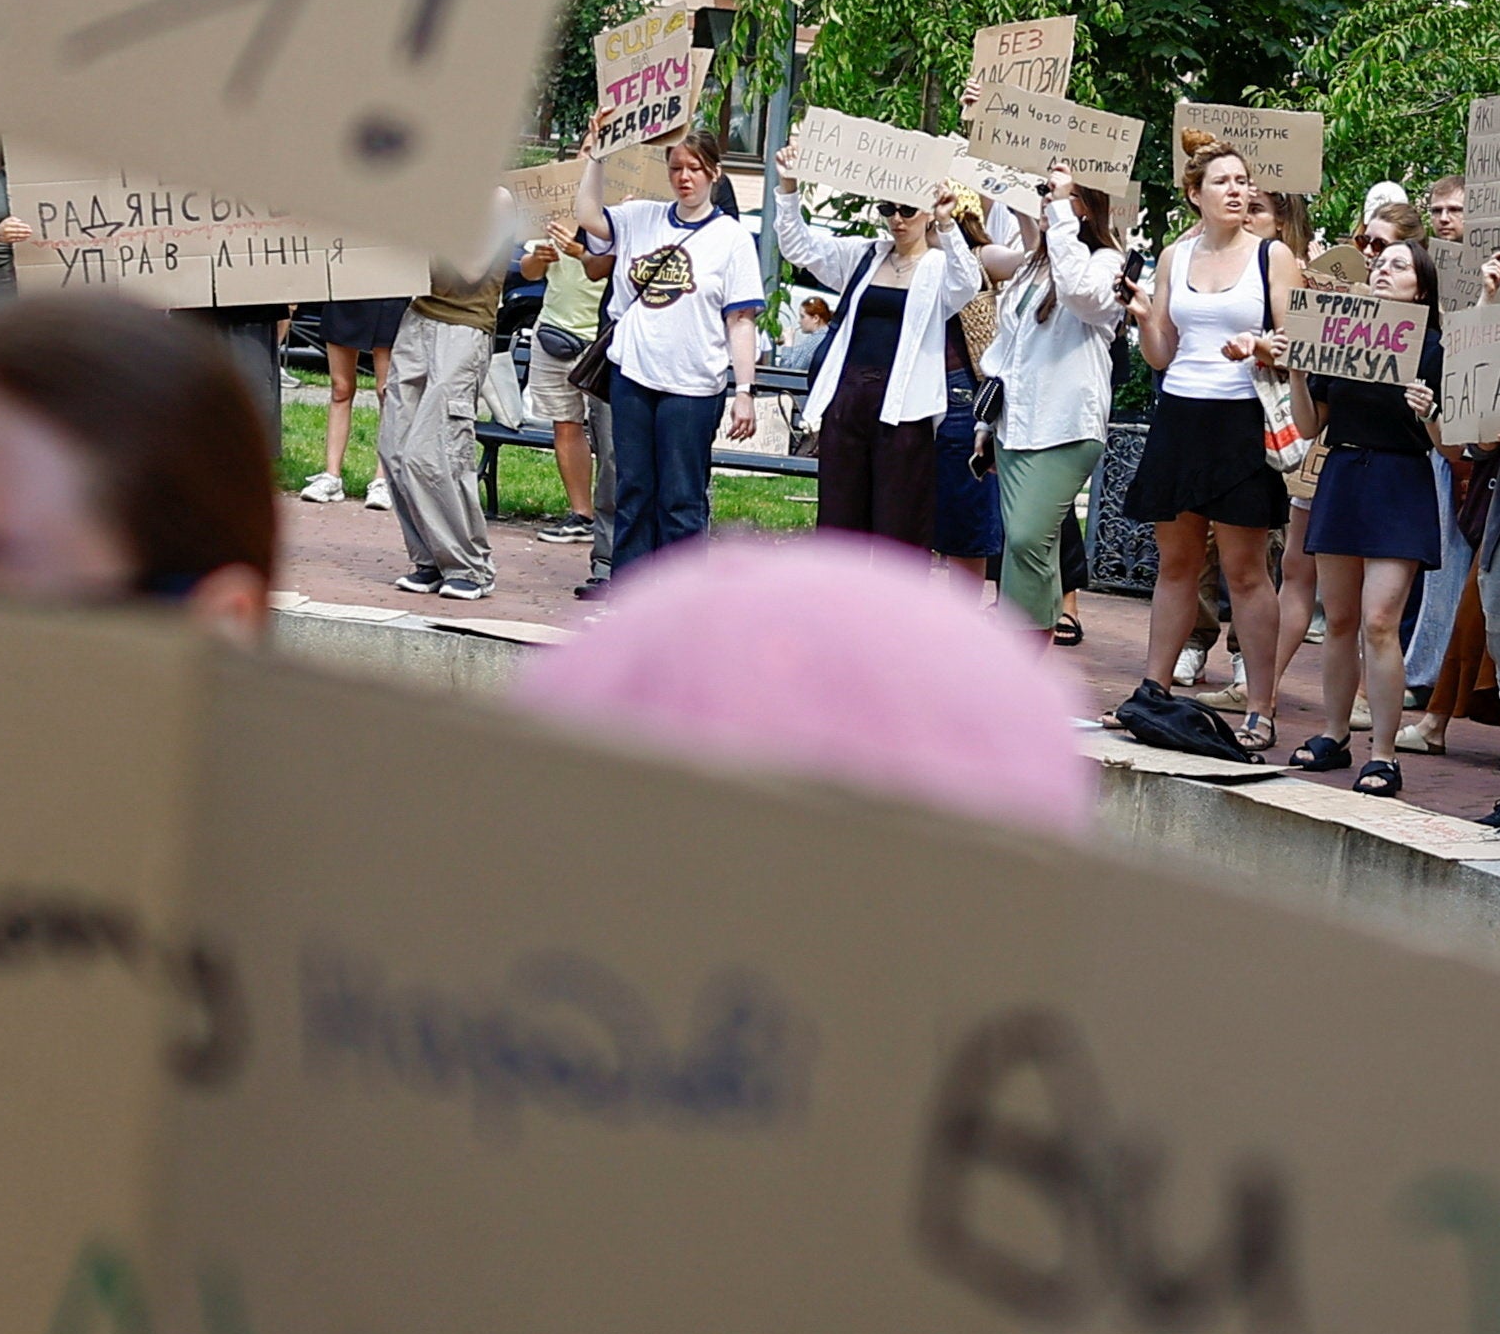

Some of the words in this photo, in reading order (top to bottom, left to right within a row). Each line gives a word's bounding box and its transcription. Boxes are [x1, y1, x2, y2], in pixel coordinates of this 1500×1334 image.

[605, 18, 662, 61] СИР
[999, 29, 1043, 56] БЕЗ
[606, 53, 690, 107] ТЕРКУ
[1187, 107, 1260, 127] ФЕДОРОВ
[1474, 102, 1494, 132] ЯКІ
[808, 121, 841, 147] НА
[857, 131, 919, 162] ВІЙНІ
[991, 127, 1030, 148] КУДИ
[1106, 126, 1130, 142] ЦЕ
[798, 149, 862, 180] НЕМАЄ
[1290, 291, 1308, 310] НА
[1316, 295, 1380, 319] ФРОНТІ
[1321, 316, 1415, 353] НЕМАЄ
[1287, 341, 1399, 383] КАНІКУЛ
